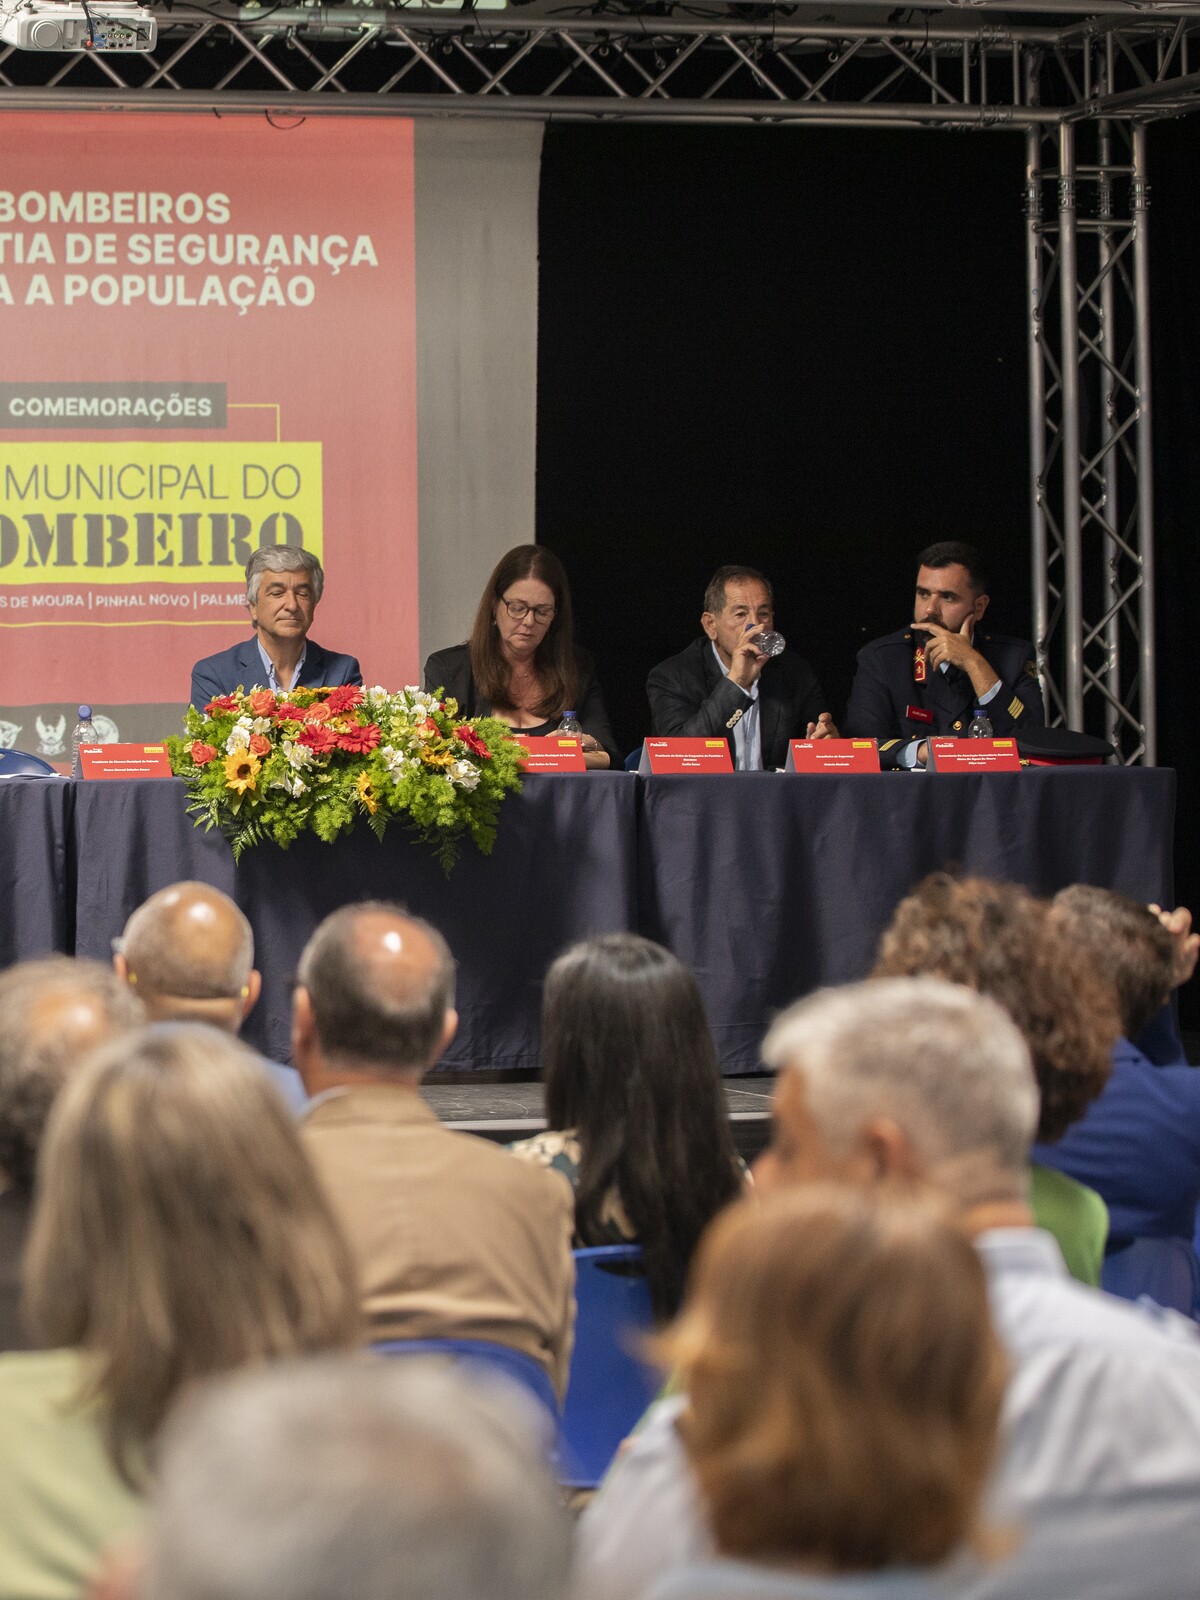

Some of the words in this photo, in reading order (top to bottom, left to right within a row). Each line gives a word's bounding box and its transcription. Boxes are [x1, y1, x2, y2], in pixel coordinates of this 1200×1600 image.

[65, 232, 117, 264] DE
[127, 233, 379, 275] SEGURANÇA
[24, 274, 55, 305] A
[64, 266, 316, 316] POPULAÇÃO
[8, 393, 212, 422] COMEMORAÇÕES
[5, 463, 229, 500] MUNICIPAL
[243, 463, 301, 500] DO
[10, 596, 29, 608] DE
[32, 594, 83, 607] MOURA
[95, 594, 146, 607] PINHAL
[149, 593, 190, 606] NOVO
[200, 594, 246, 606] PALME
